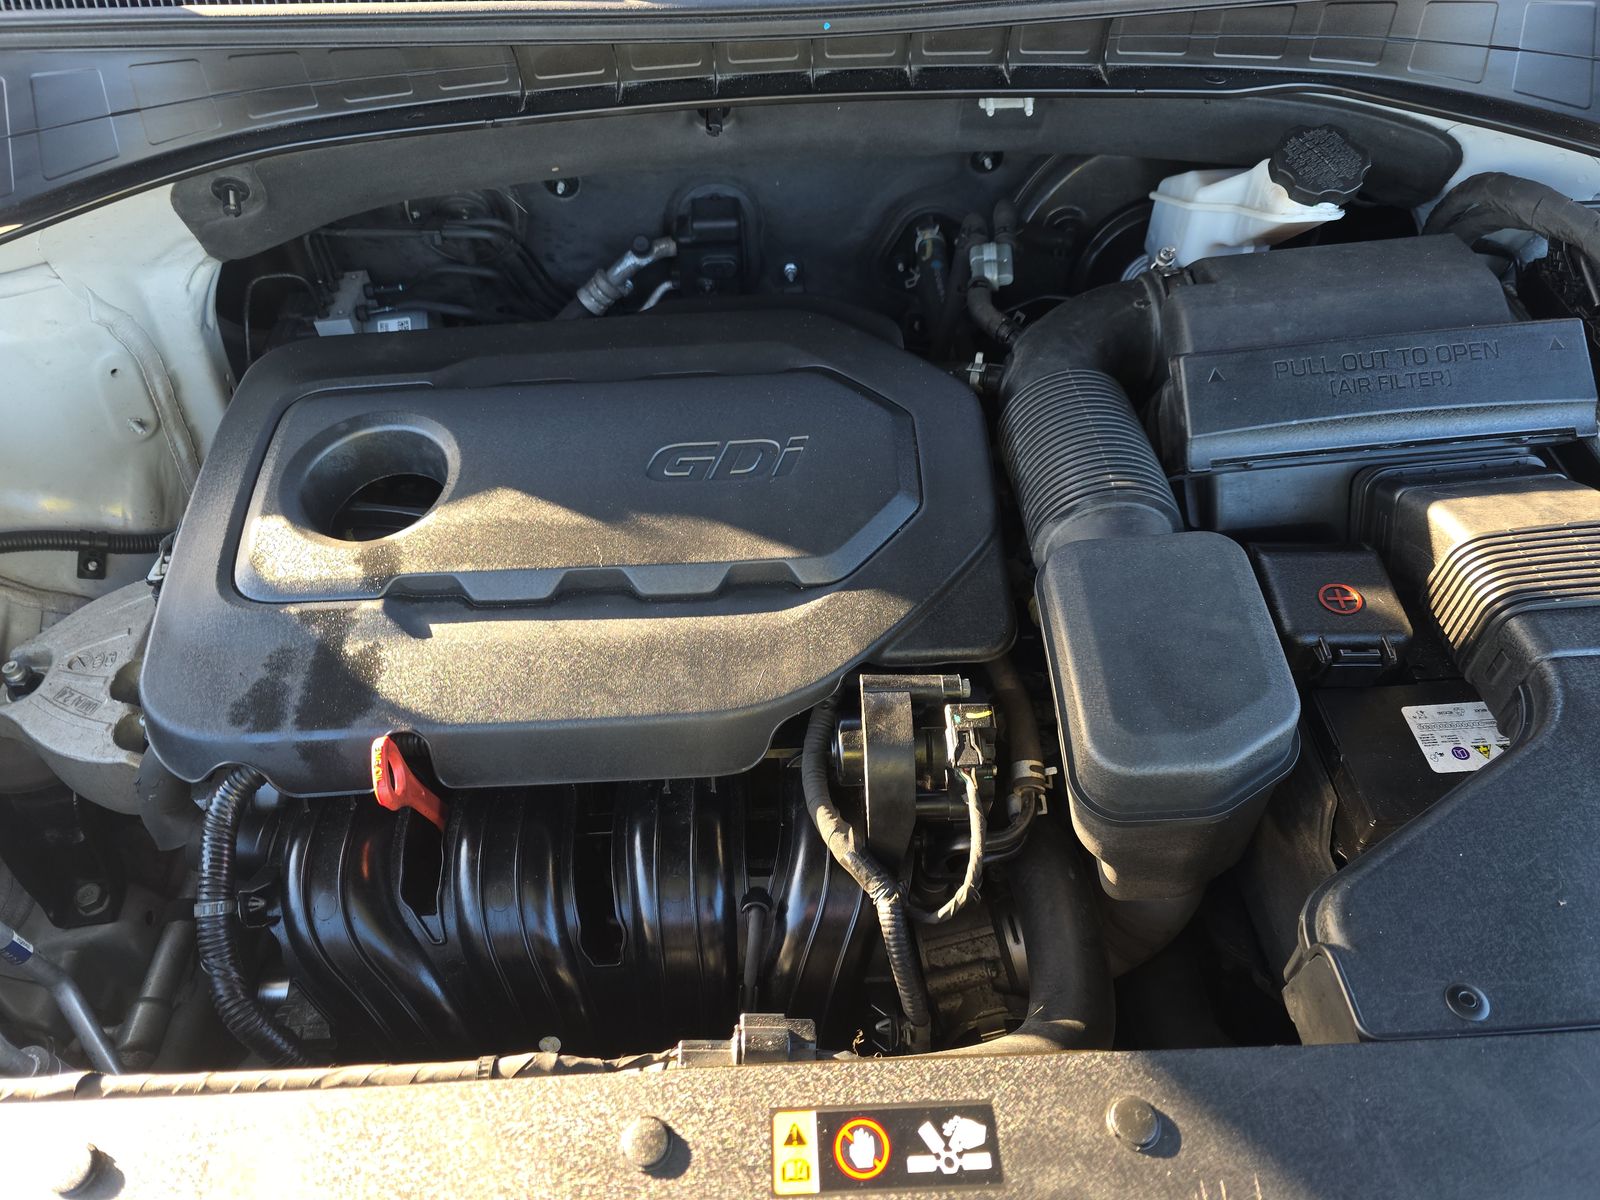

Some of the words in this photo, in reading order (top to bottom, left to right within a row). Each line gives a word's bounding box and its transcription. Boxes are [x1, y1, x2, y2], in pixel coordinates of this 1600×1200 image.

[1273, 355, 1336, 380] PULL
[1341, 350, 1390, 373] OUT
[1395, 347, 1429, 368] TO
[1434, 340, 1500, 364] OPEN
[646, 435, 809, 480] GDi
